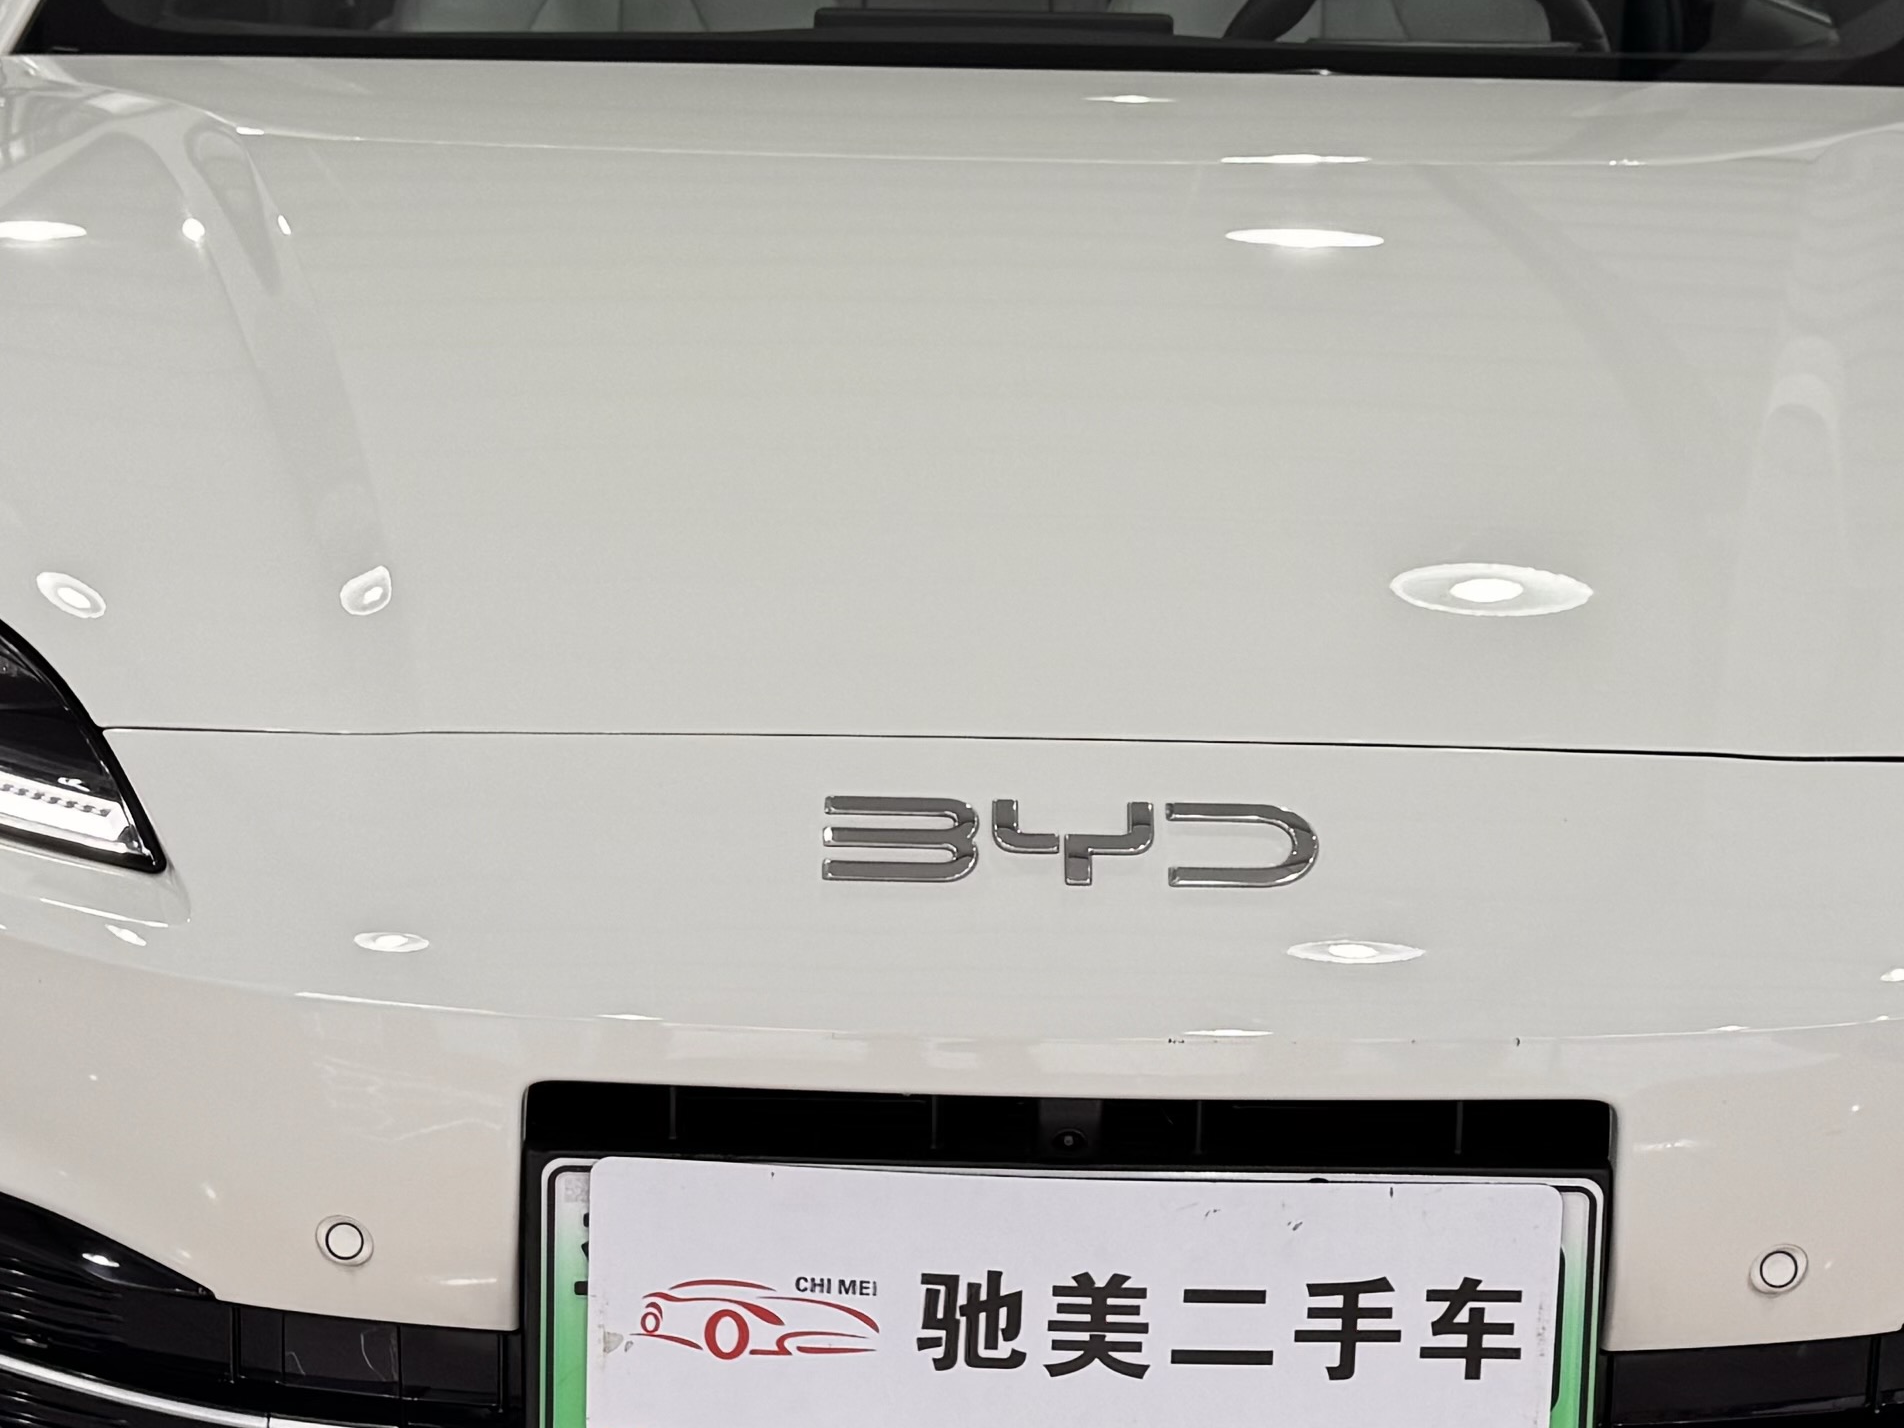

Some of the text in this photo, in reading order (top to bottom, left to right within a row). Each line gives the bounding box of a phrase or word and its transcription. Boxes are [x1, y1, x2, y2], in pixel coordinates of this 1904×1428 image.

[822, 795, 1319, 887] BYD
[795, 1276, 878, 1297] CHI MEI
[916, 1268, 1524, 1382] 驰美二手车
